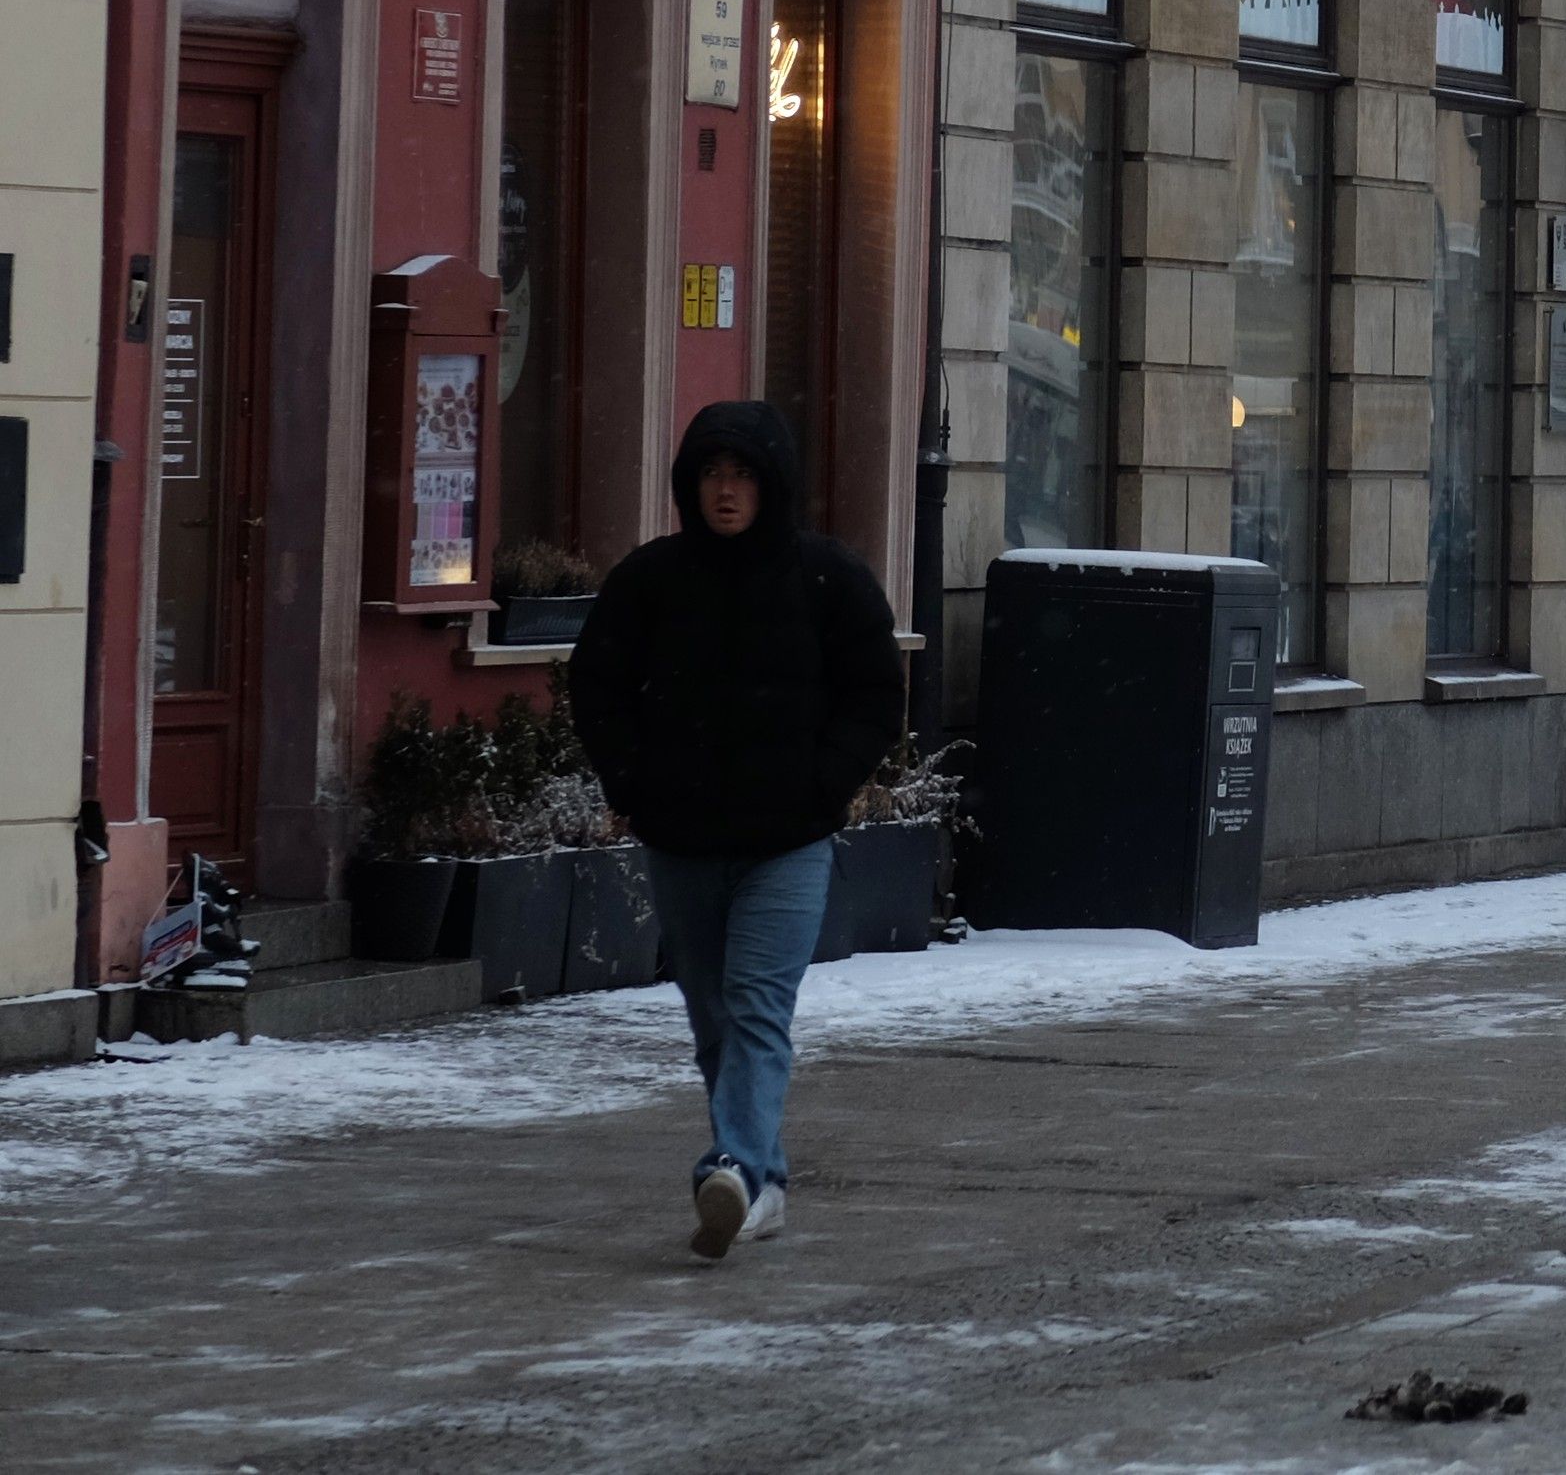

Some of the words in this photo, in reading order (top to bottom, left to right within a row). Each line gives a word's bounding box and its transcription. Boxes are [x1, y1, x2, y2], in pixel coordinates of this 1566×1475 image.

[715, 0, 728, 19] 59
[1223, 716, 1257, 734] WRZUTNIA
[1226, 734, 1252, 759] KSIĄŻEK
